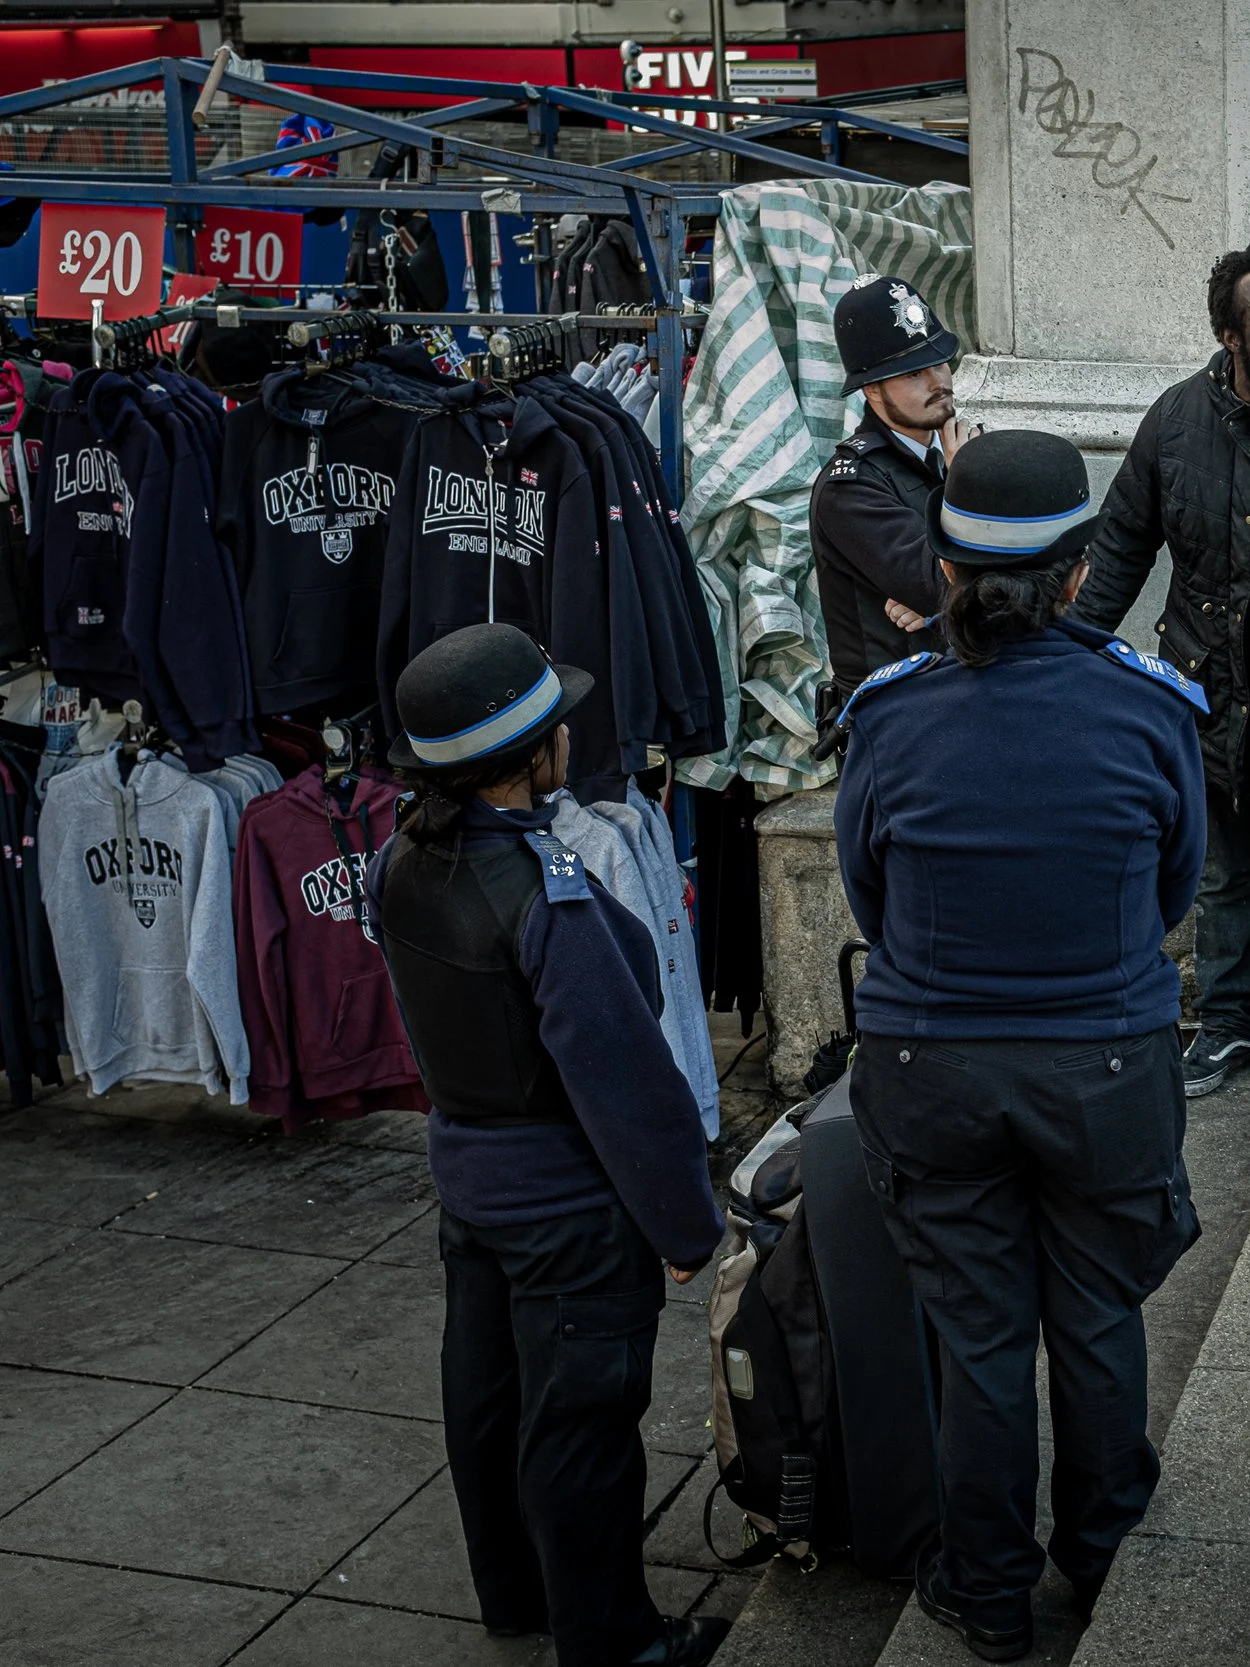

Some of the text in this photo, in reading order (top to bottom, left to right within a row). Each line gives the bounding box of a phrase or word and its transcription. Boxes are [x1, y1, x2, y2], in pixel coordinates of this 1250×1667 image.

[58, 229, 143, 297] £20
[209, 227, 284, 283] £10
[829, 466, 856, 476] 1274
[289, 510, 378, 534] UNIVRSITY
[424, 465, 546, 541] LONDON
[448, 533, 532, 567] ENGLAND
[111, 880, 178, 898] UNVERSITY
[300, 850, 378, 917] OXF
